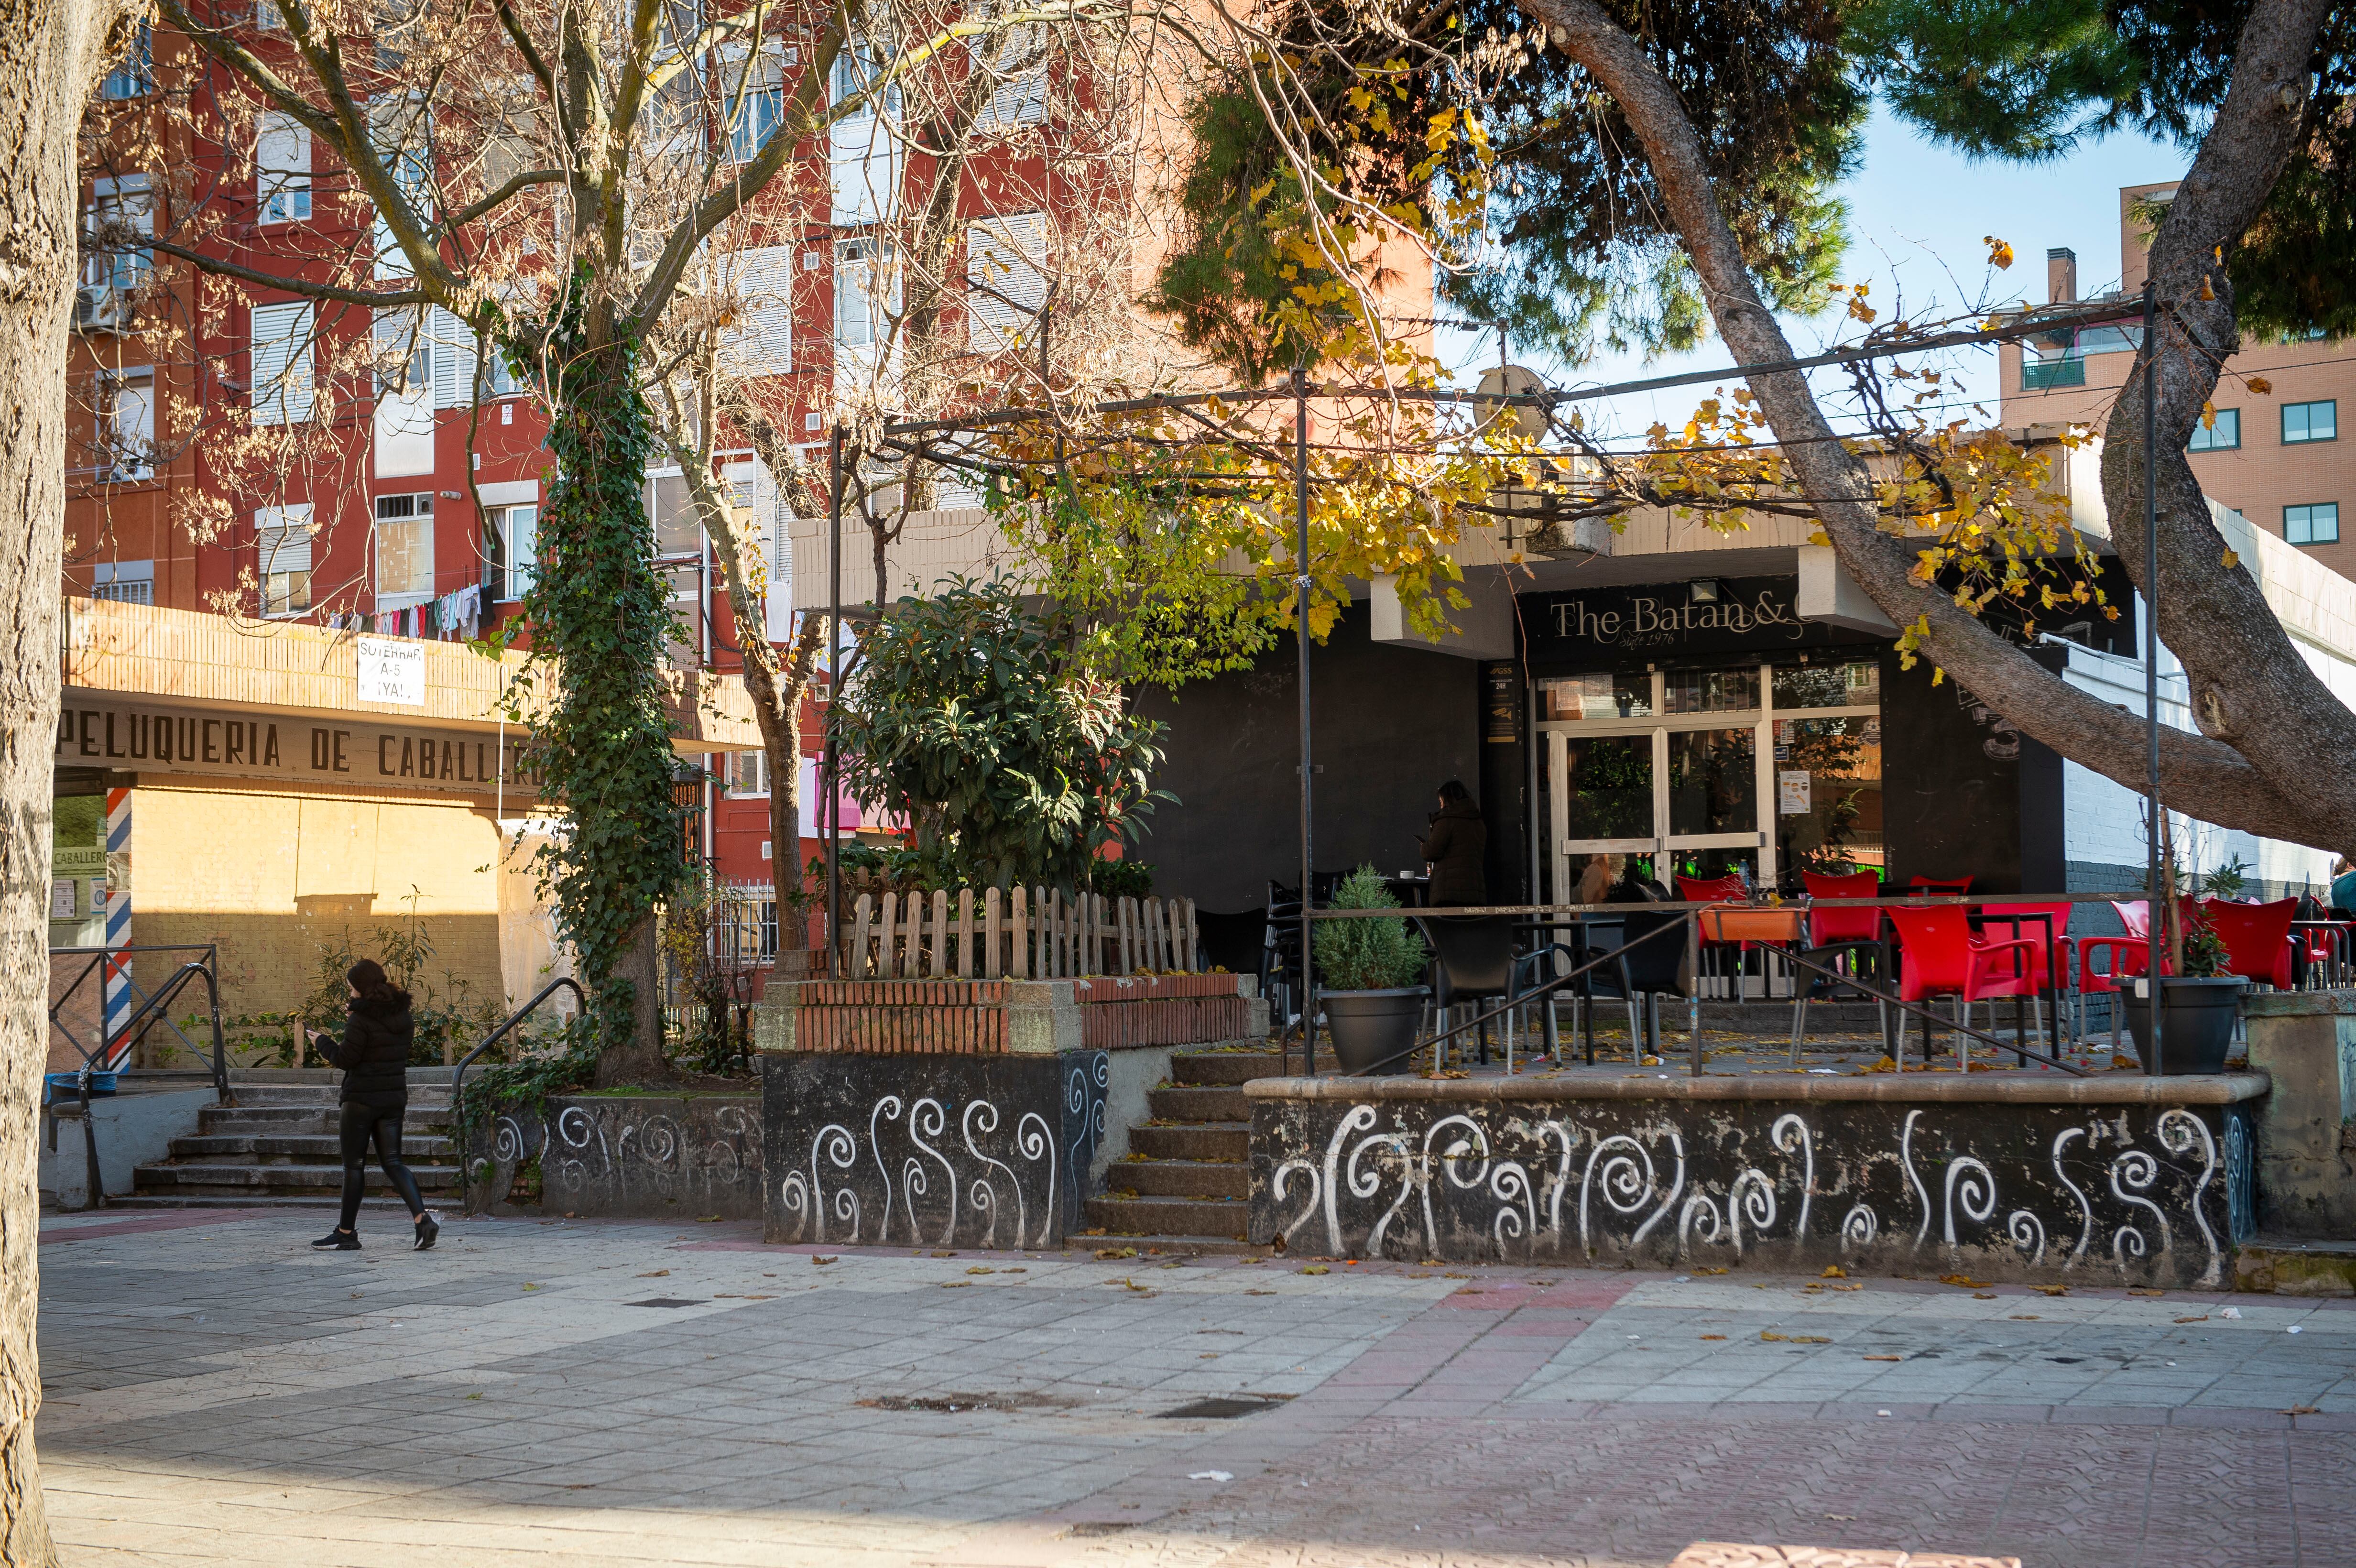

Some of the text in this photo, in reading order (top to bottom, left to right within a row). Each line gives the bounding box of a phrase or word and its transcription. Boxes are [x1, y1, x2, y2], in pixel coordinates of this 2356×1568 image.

[1550, 597, 1621, 643] The
[1631, 596, 1754, 637] Batan
[1755, 591, 1802, 639] &
[1619, 629, 1645, 650] Since
[381, 663, 400, 676] A-5
[378, 682, 403, 697] ¡YA!
[55, 709, 281, 767] PELUQUERIA
[311, 728, 350, 773] DE
